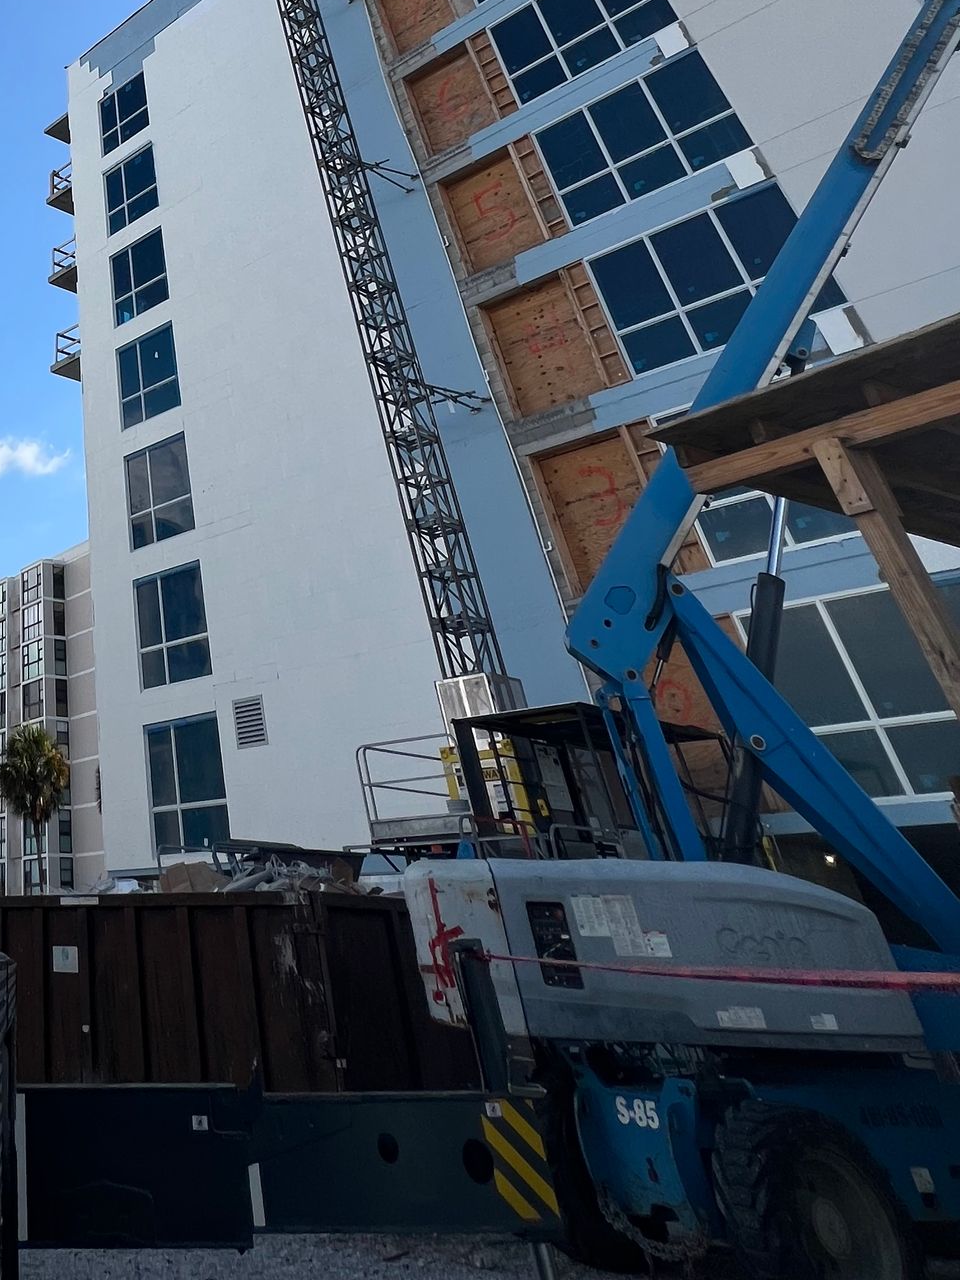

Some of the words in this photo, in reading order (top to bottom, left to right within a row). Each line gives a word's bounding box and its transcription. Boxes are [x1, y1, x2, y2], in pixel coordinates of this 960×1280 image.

[473, 181, 516, 241] 5
[578, 466, 626, 526] 3
[615, 1095, 660, 1129] S-85
